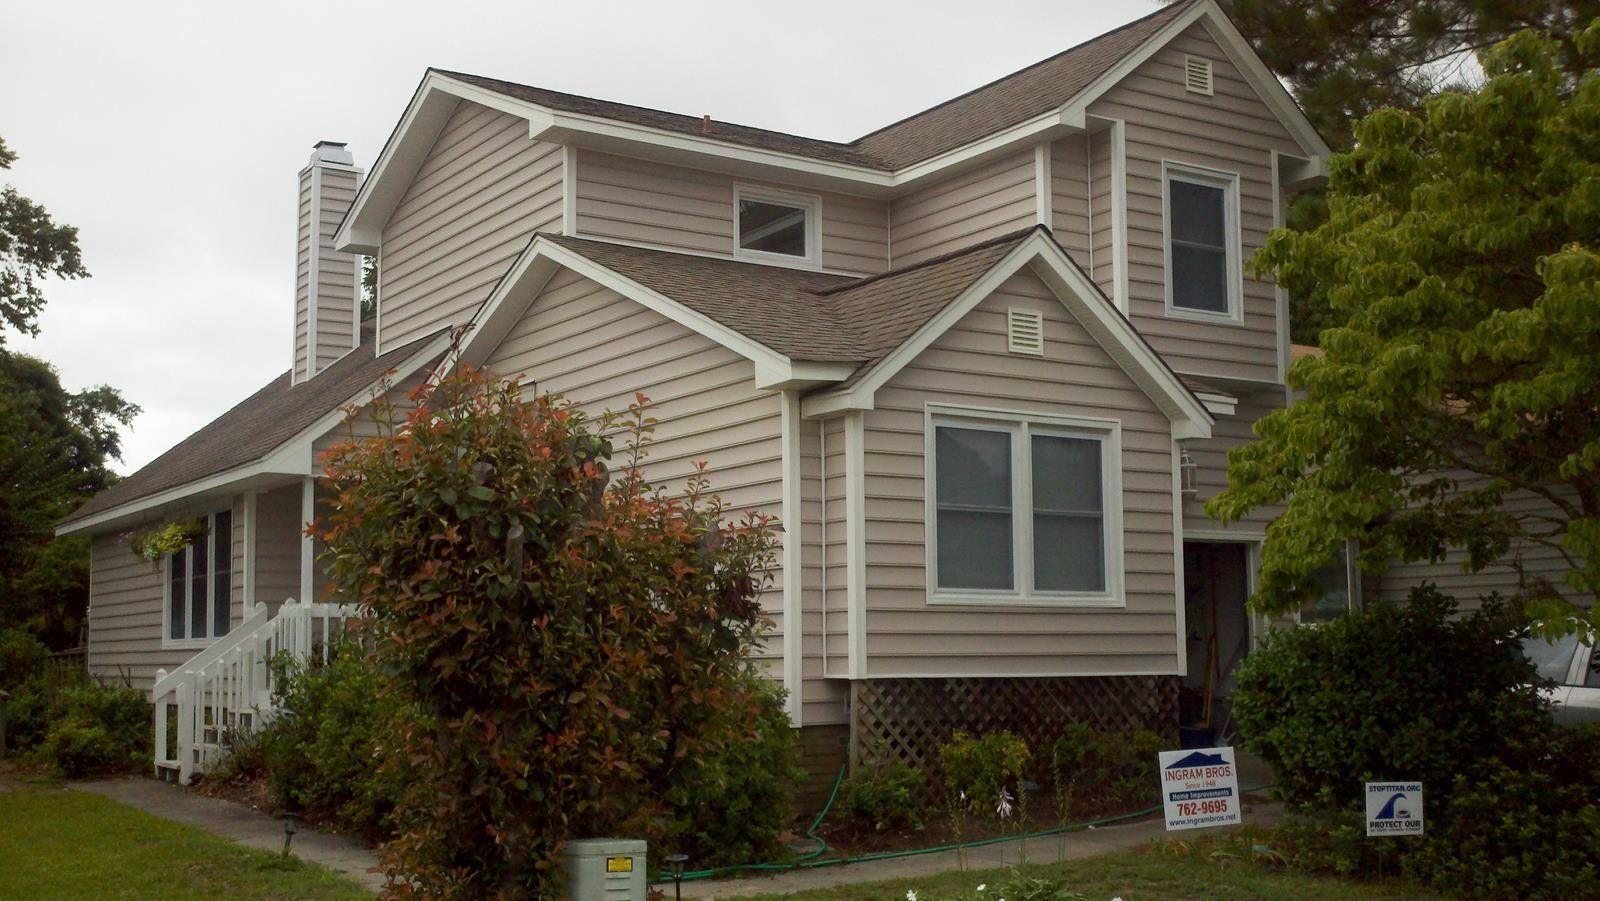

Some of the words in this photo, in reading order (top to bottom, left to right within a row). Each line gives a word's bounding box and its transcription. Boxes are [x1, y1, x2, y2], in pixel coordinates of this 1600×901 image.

[1165, 769, 1203, 782] INGRAM
[1177, 800, 1227, 816] 762-9695
[1169, 814, 1236, 826] www.ingrambros.net
[1370, 820, 1402, 828] PROTECT
